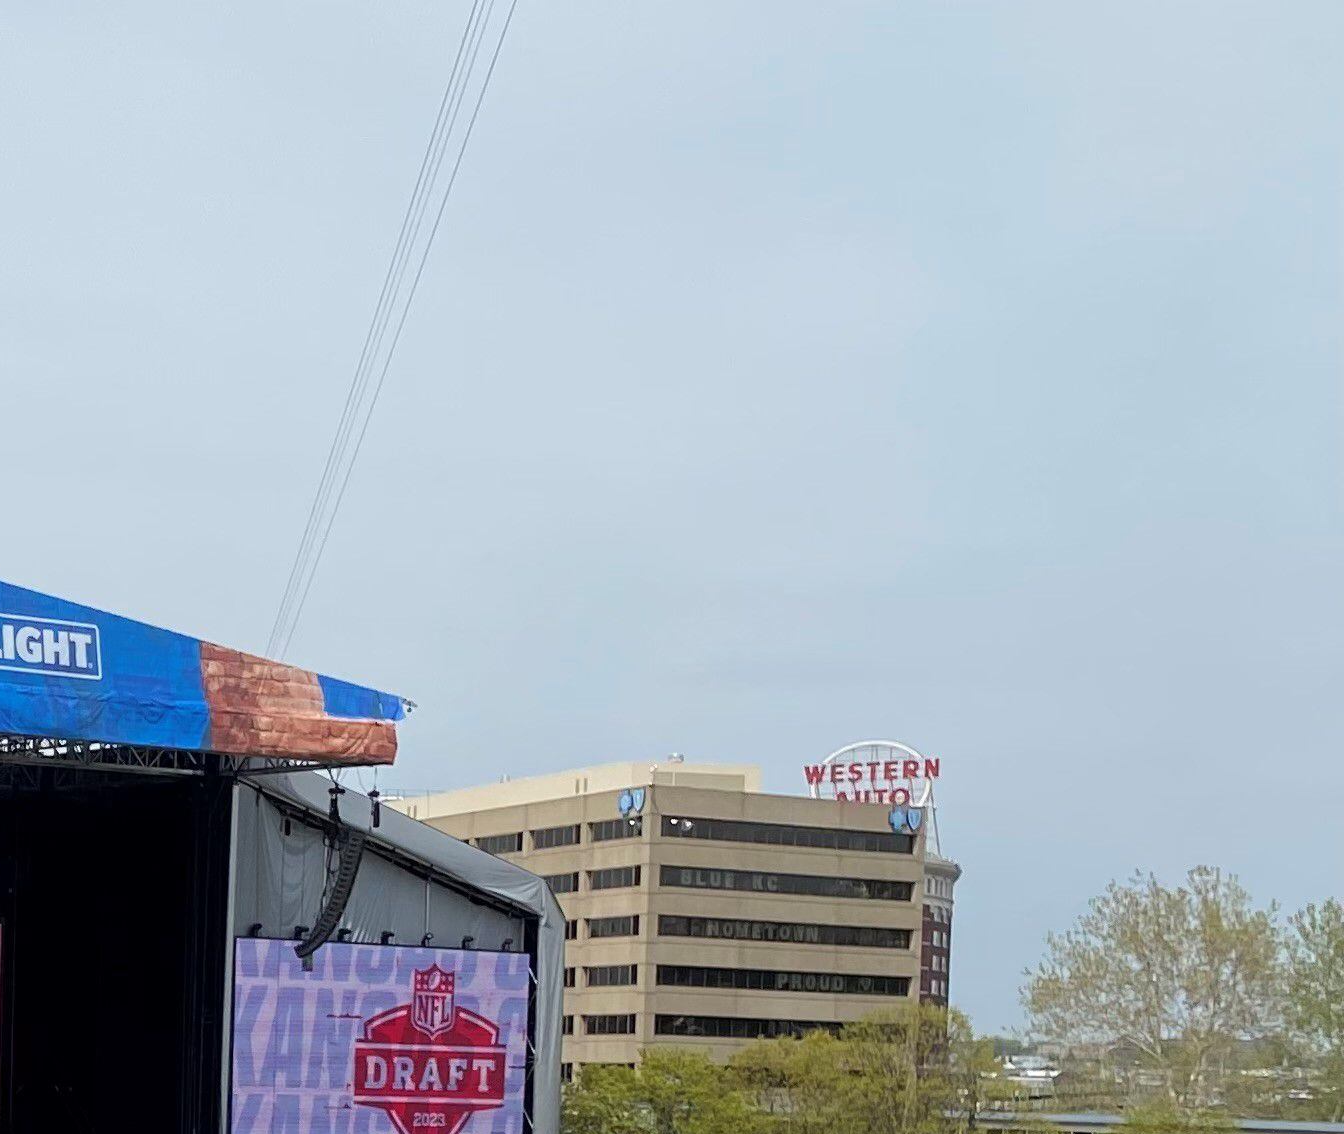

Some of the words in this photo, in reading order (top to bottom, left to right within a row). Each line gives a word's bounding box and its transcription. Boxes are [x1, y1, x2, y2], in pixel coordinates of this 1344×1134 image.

[804, 759, 940, 785] WESTERN
[836, 788, 911, 806] AUTO
[681, 868, 735, 889] BLUE
[705, 918, 819, 942] HOMETOWN
[775, 971, 846, 992] PROUD
[415, 994, 450, 1027] NFL
[364, 1055, 496, 1093] DRAFT
[413, 1112, 446, 1127] 2023
